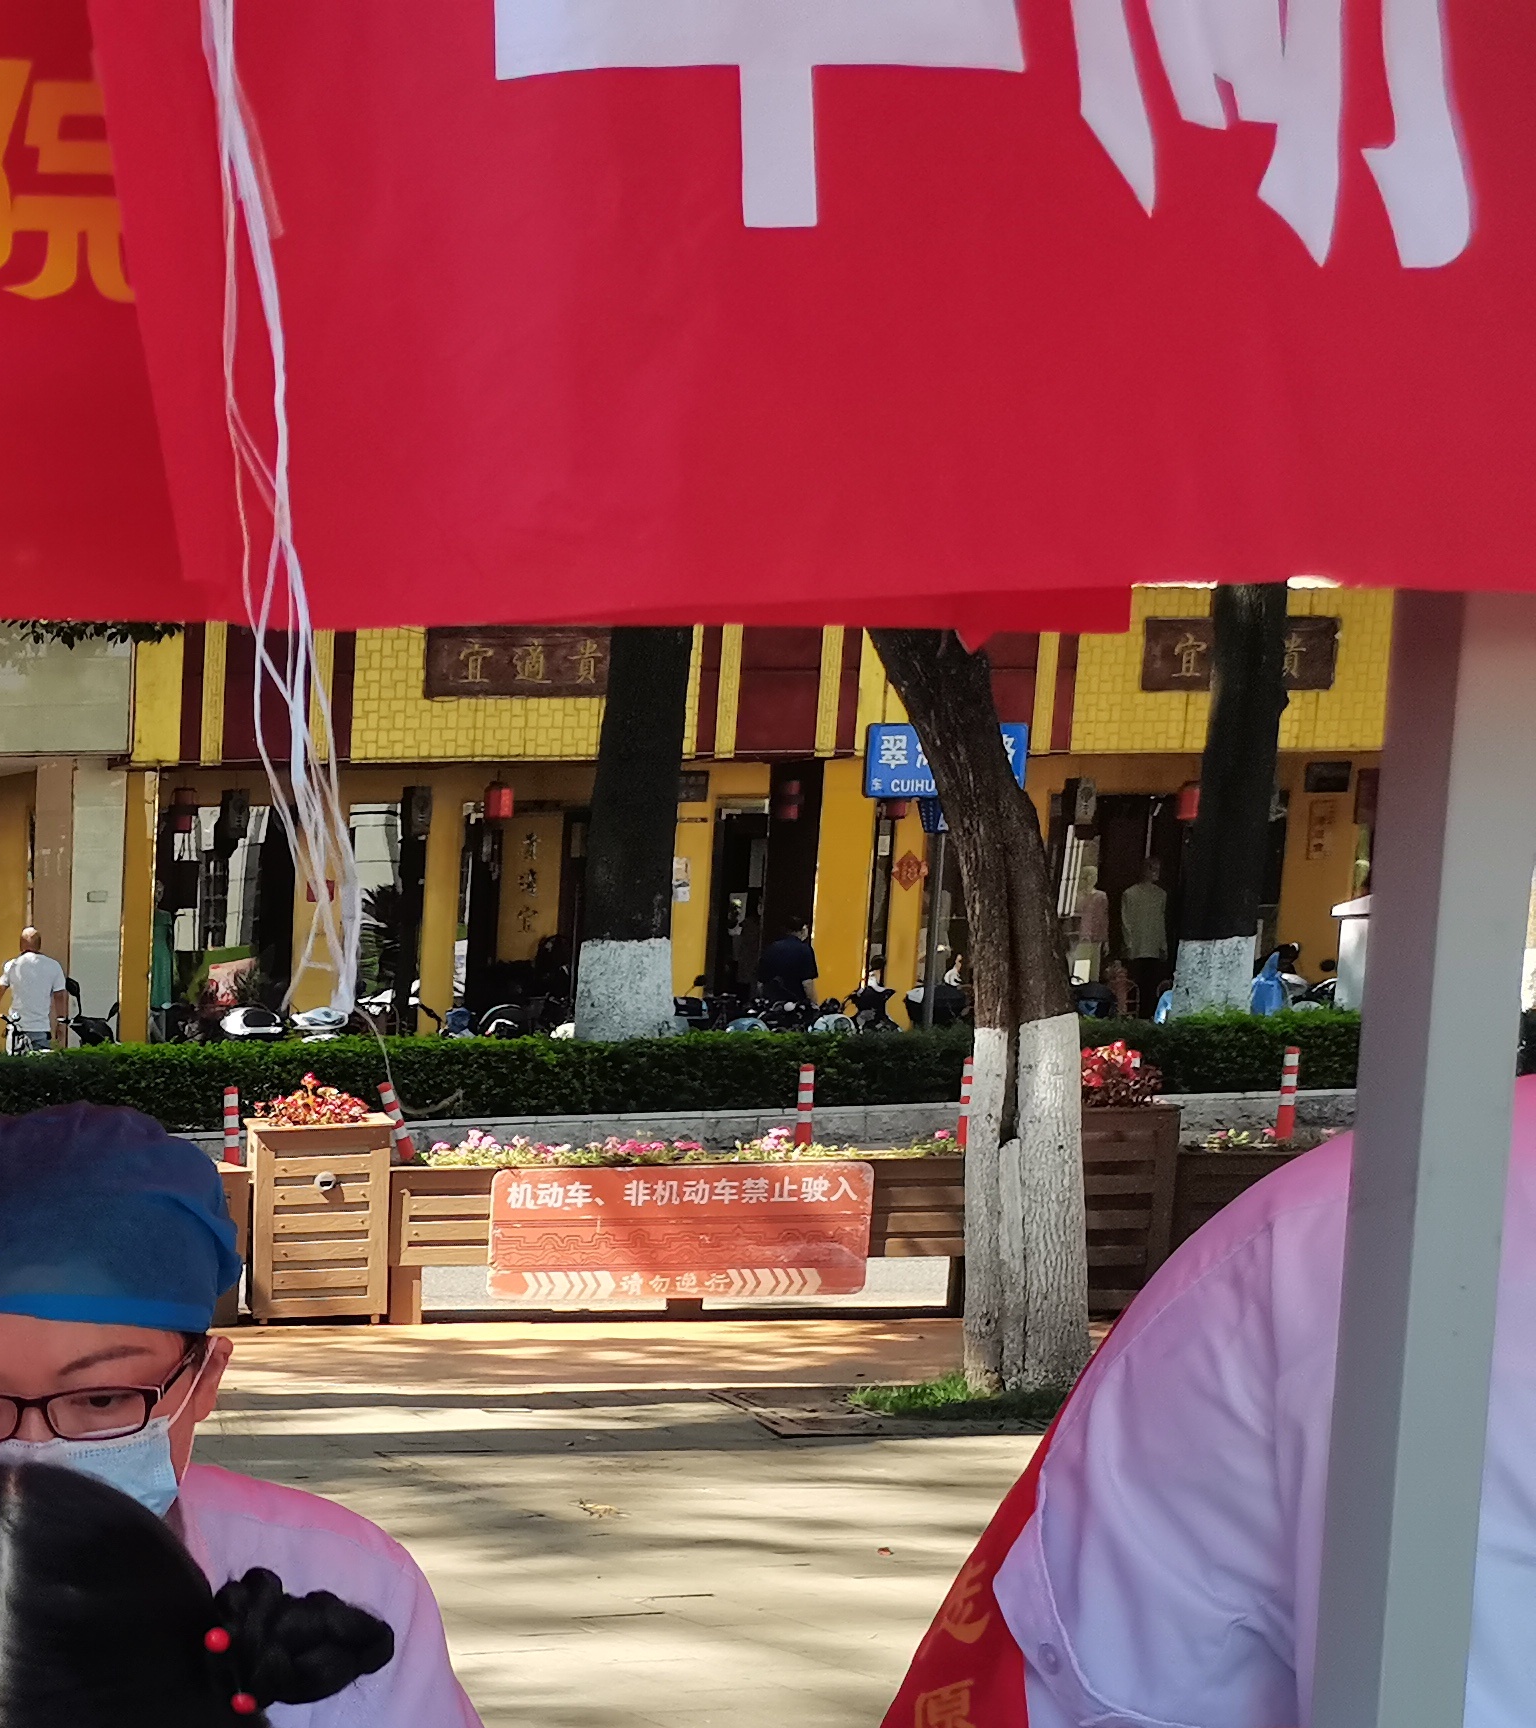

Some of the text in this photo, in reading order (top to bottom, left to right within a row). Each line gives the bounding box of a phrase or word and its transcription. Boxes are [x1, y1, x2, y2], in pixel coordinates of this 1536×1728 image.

[507, 1175, 858, 1210] 机动车、非机动车禁止驶入
[619, 1271, 730, 1296] 请勿逆行
